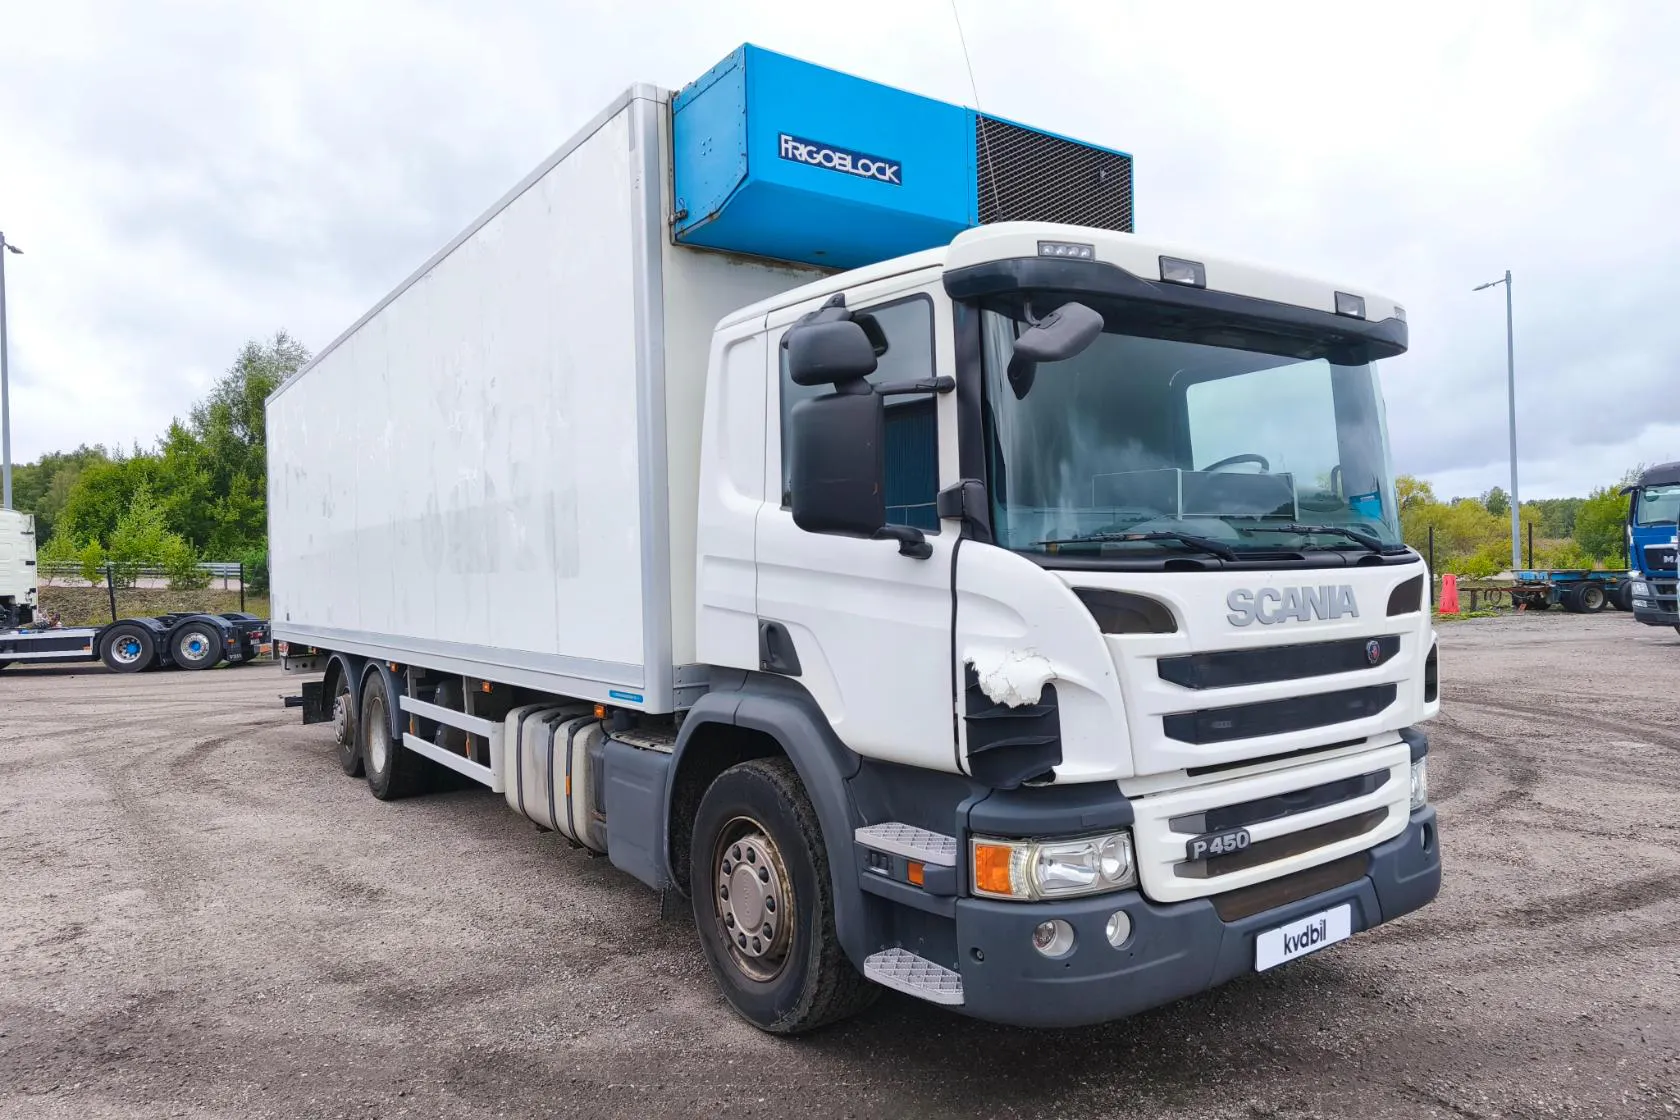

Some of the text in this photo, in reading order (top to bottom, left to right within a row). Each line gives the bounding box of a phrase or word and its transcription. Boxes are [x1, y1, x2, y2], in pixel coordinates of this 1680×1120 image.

[780, 134, 900, 184] FRIGOBLOCK
[1226, 584, 1360, 627] SCANIA
[1193, 831, 1250, 860] P 450
[1283, 919, 1327, 955] kvdbil
